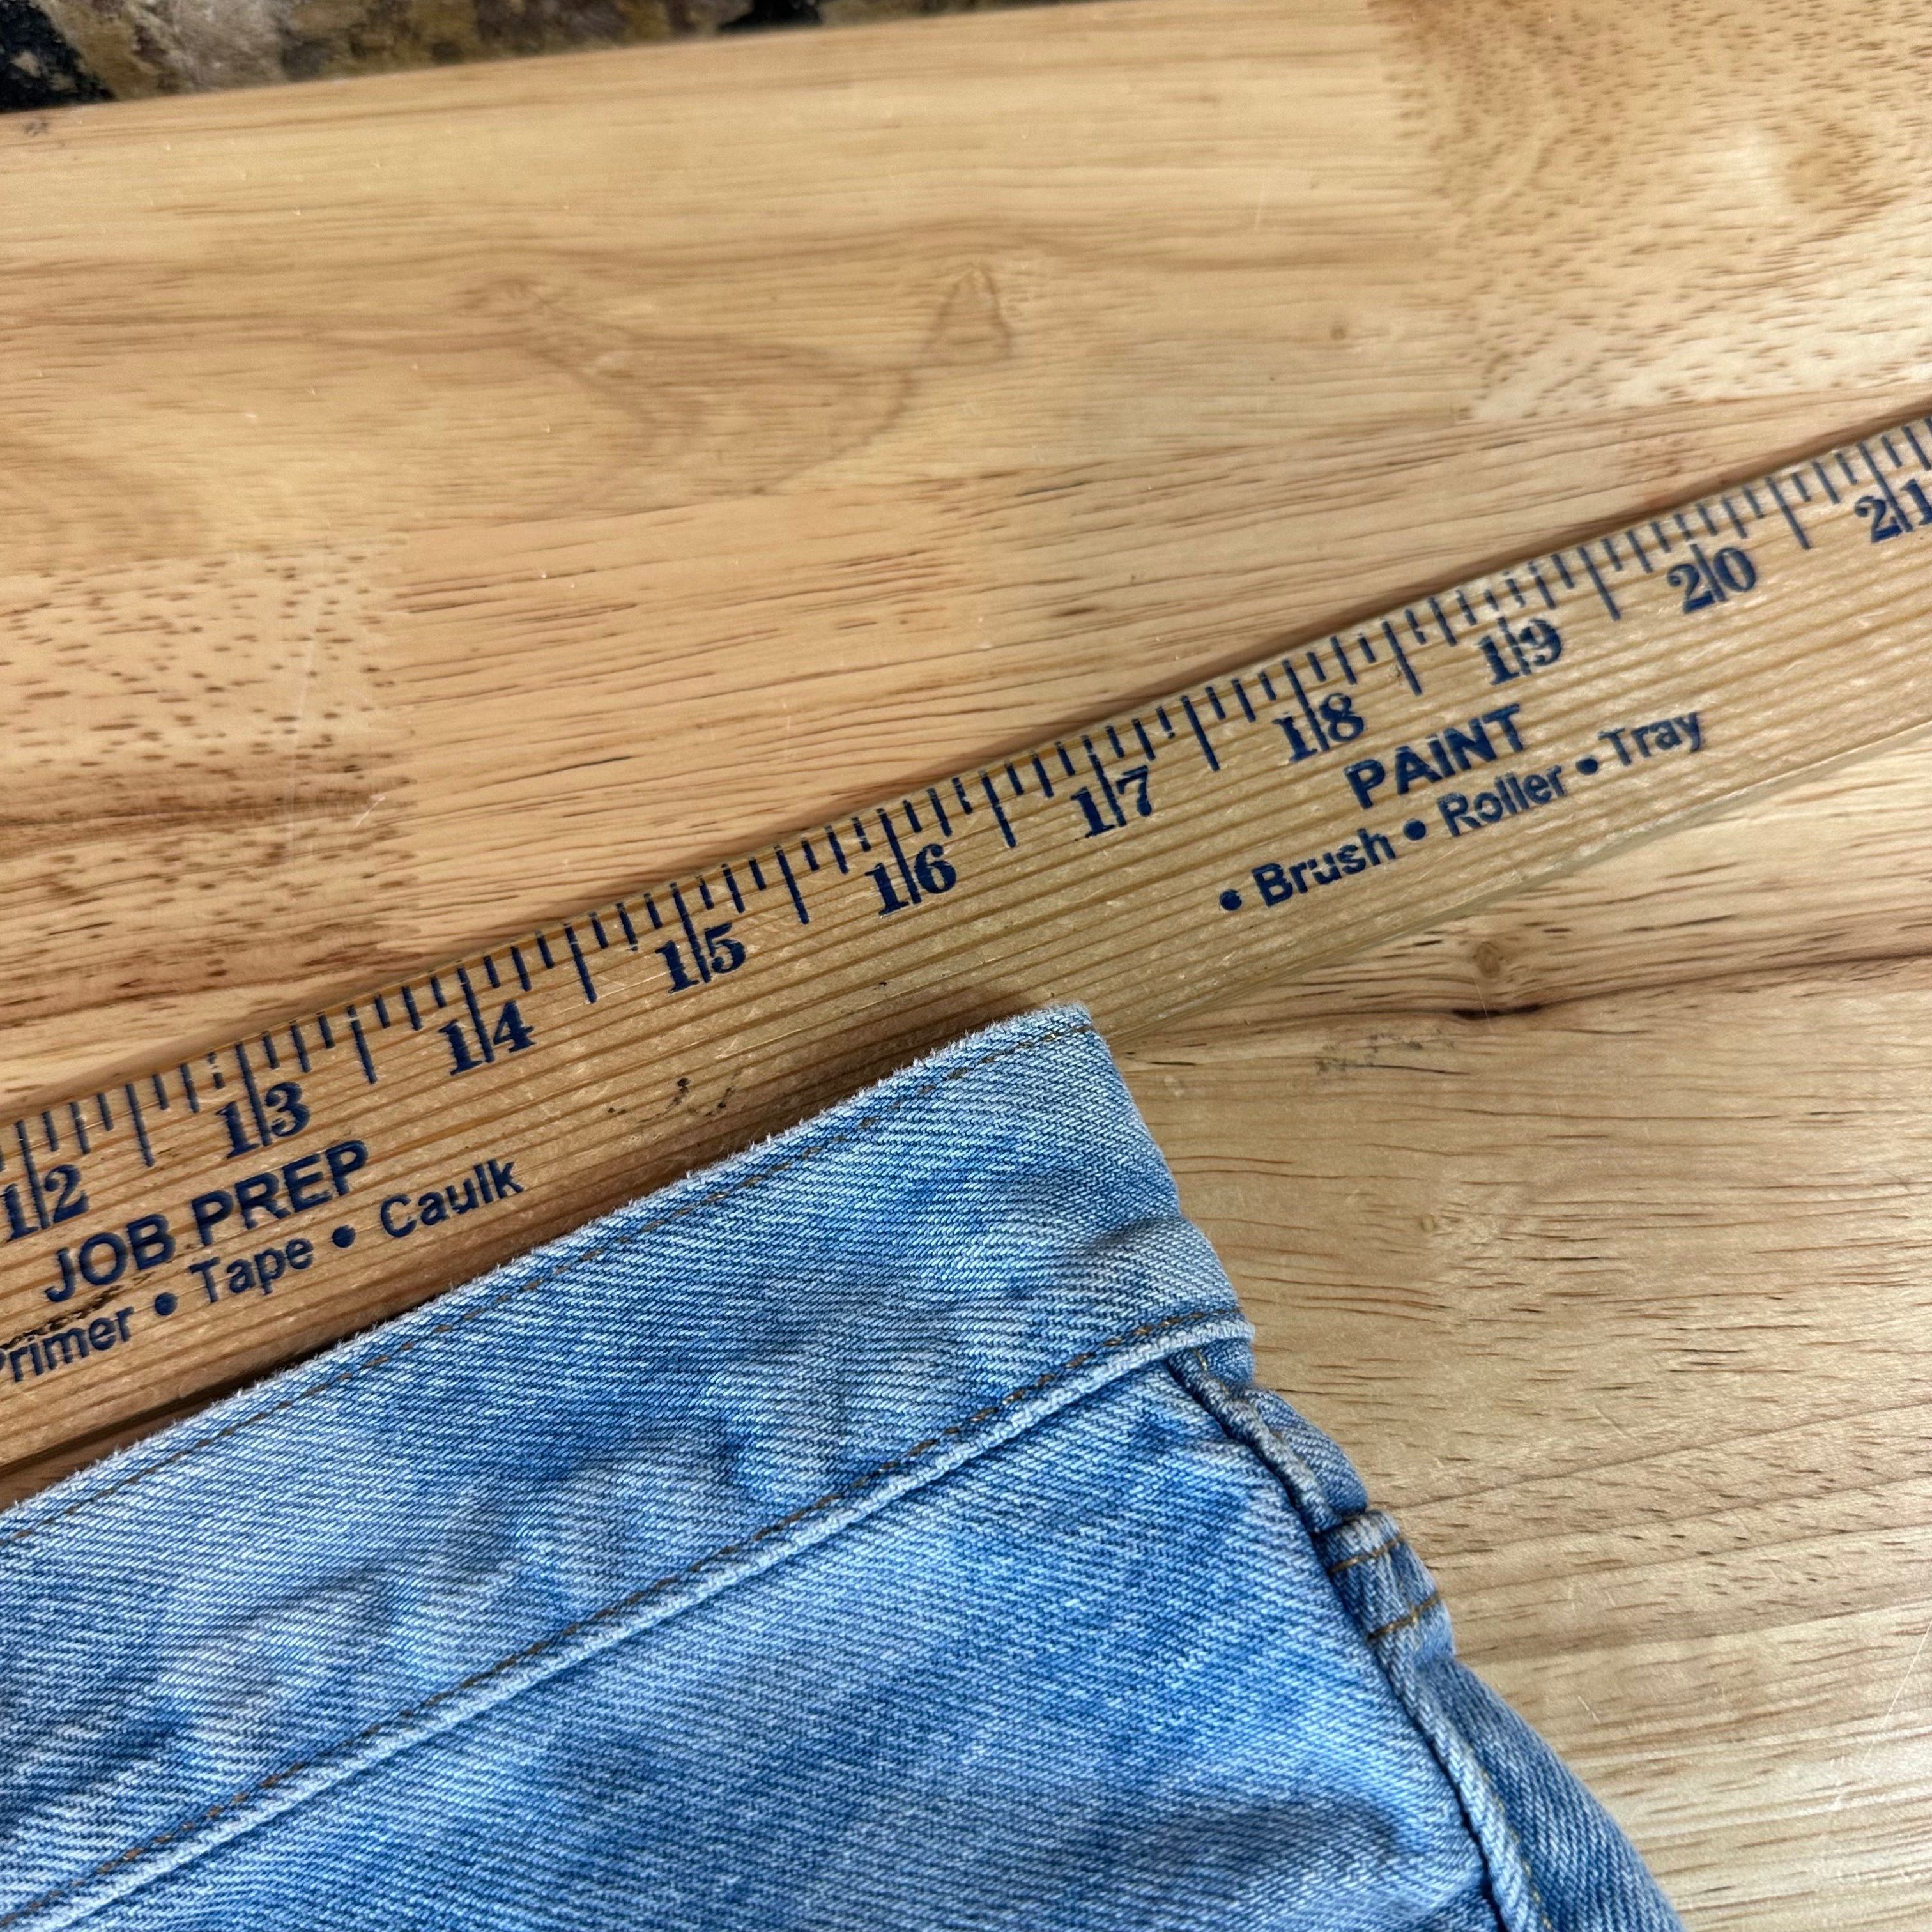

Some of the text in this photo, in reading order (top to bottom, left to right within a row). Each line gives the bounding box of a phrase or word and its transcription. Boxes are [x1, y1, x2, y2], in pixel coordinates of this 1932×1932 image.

[1252, 711, 1704, 906] Brush Roller Tray
[1346, 703, 1525, 809] PAINT
[0, 479, 1932, 1242] 12 13 14 15 16 17 18 19 20 21
[45, 1140, 369, 1303] JOB PREP
[190, 1237, 313, 1303] Tape
[380, 1158, 525, 1239] Caulk
